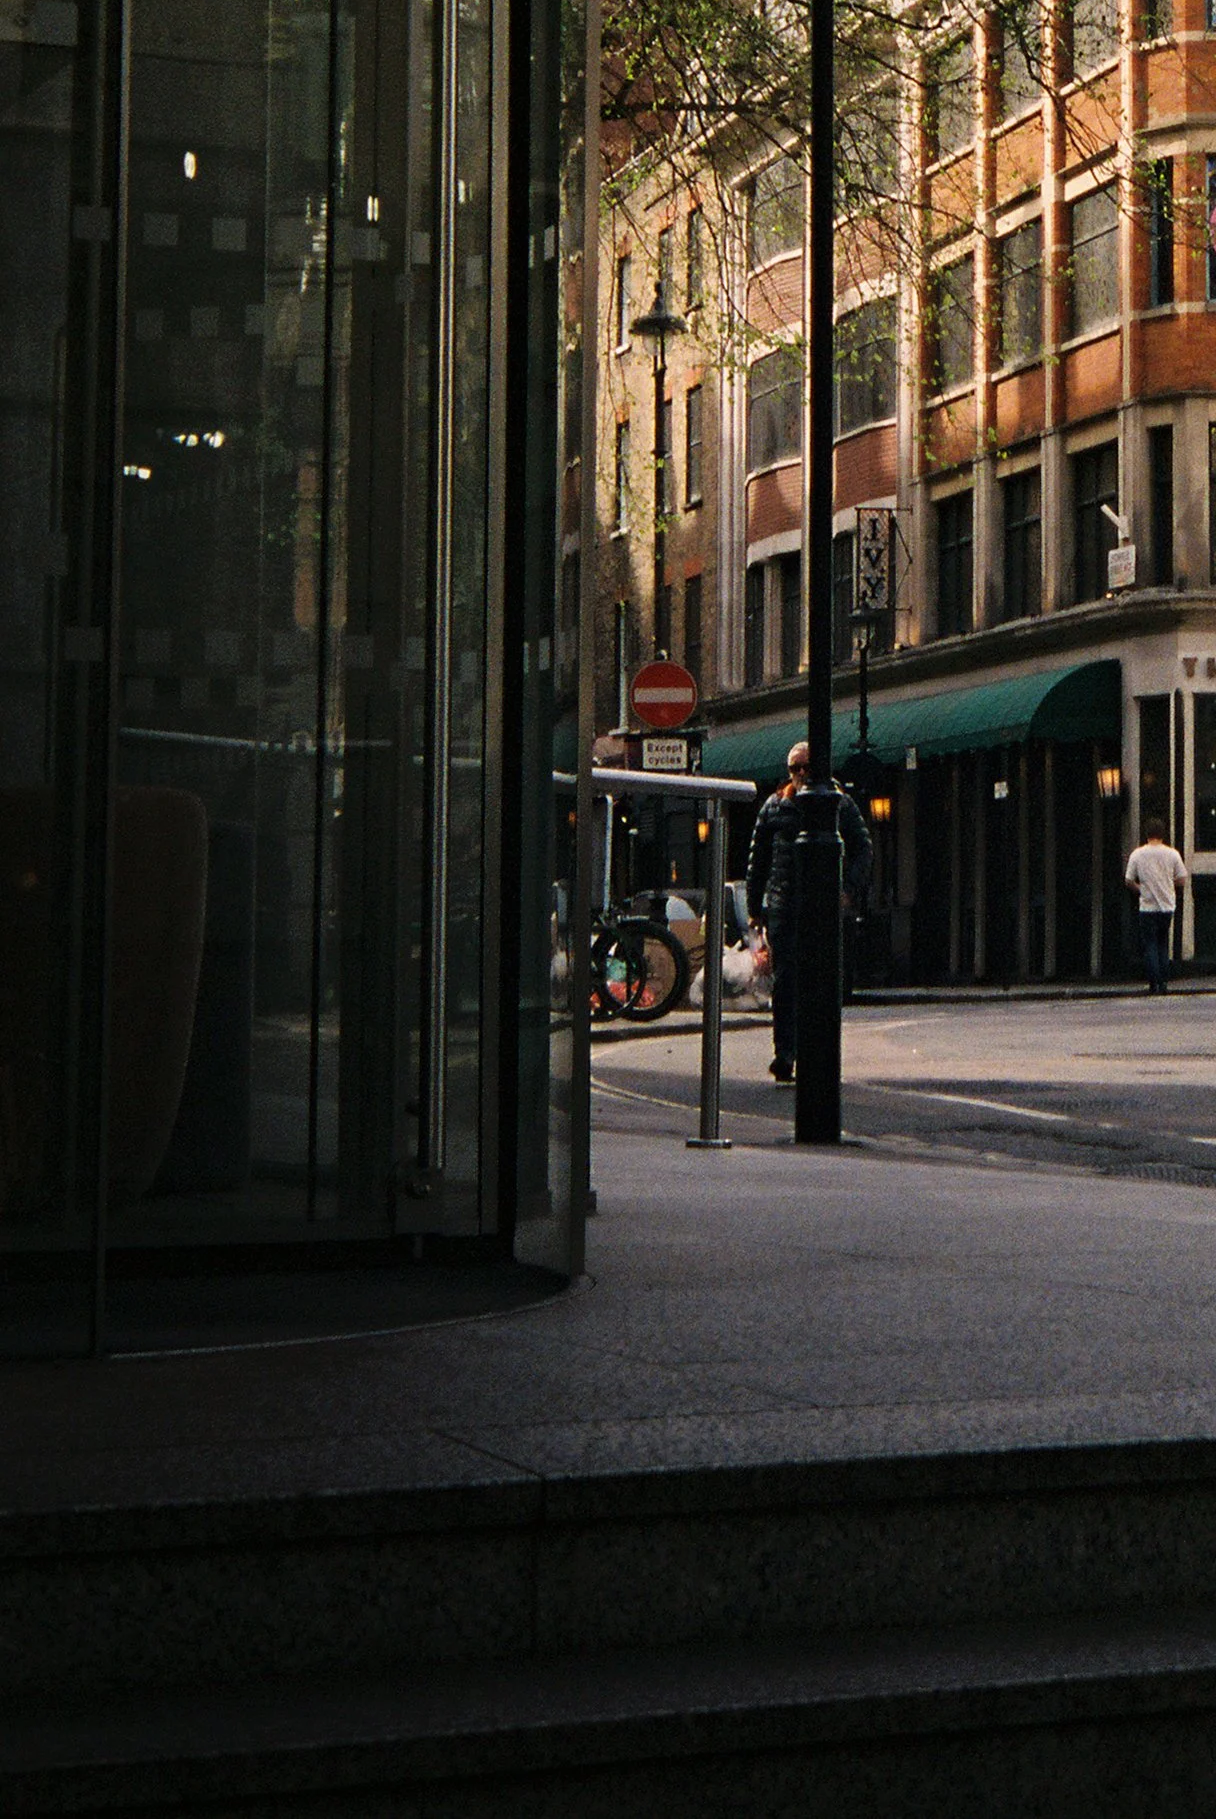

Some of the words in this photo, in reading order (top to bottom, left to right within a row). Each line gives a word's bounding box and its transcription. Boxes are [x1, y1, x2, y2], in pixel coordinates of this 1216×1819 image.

[864, 517, 886, 599] IVY
[647, 743, 683, 754] Except
[648, 756, 682, 766] cycles
